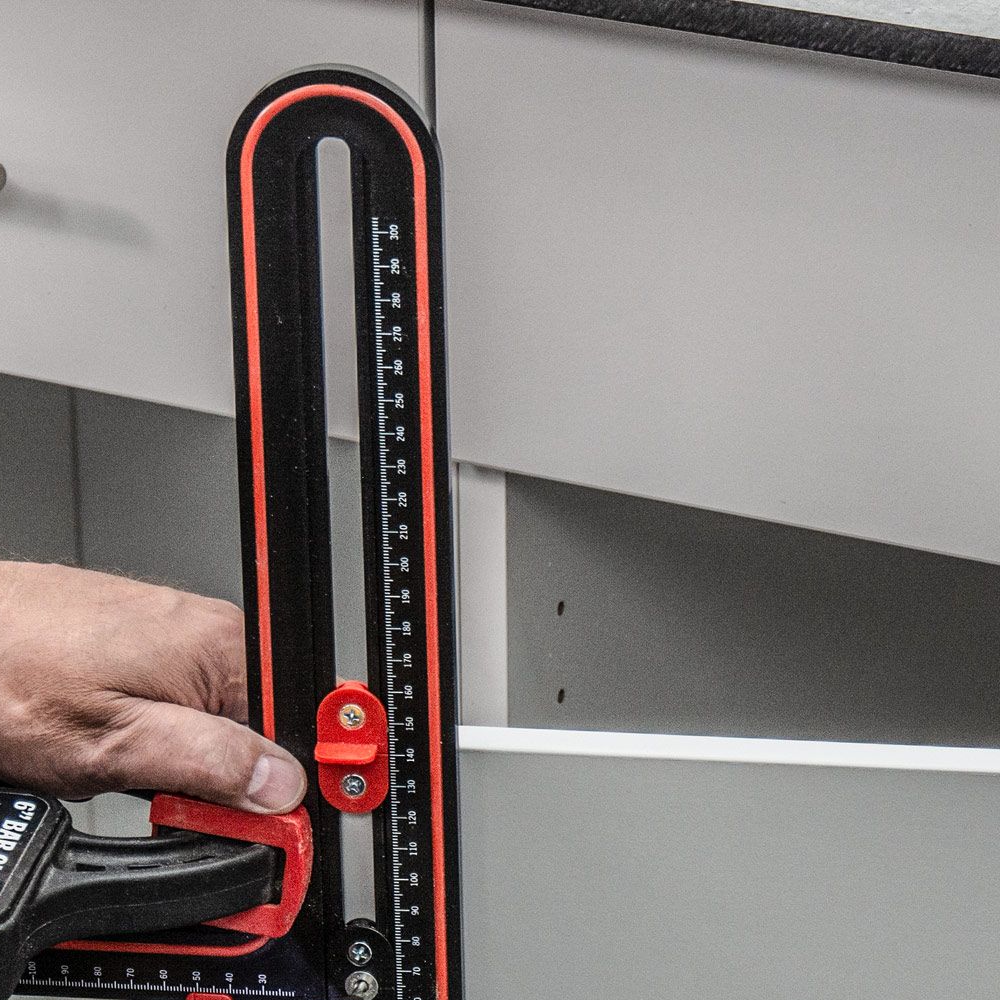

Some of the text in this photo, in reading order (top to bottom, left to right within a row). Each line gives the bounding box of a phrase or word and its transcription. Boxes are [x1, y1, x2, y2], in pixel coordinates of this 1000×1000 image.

[390, 224, 398, 240] 300
[391, 259, 400, 274] 290
[392, 292, 400, 308] 280
[393, 326, 402, 342] 270
[394, 360, 402, 375] 260
[395, 393, 404, 408] 250
[396, 426, 405, 441] 240
[397, 459, 406, 474] 230
[398, 492, 407, 507] 220
[400, 525, 408, 540] 210
[401, 557, 409, 572] 200
[402, 589, 410, 604] 190
[402, 622, 411, 636] 180
[403, 654, 412, 668] 170
[404, 685, 413, 699] 160
[405, 717, 414, 730] 150
[406, 748, 414, 762] 140
[407, 780, 416, 793] 130
[408, 811, 416, 824] 120
[409, 842, 417, 856] 110
[410, 873, 418, 886] 100
[411, 906, 419, 915] 90
[412, 936, 420, 946] 80
[61, 965, 69, 974] 90
[94, 967, 102, 976] 80
[126, 968, 134, 977] 70
[160, 970, 167, 979] 60
[192, 971, 200, 980] 50
[413, 967, 420, 976] 70
[226, 973, 233, 982] 40
[258, 974, 266, 984] 30
